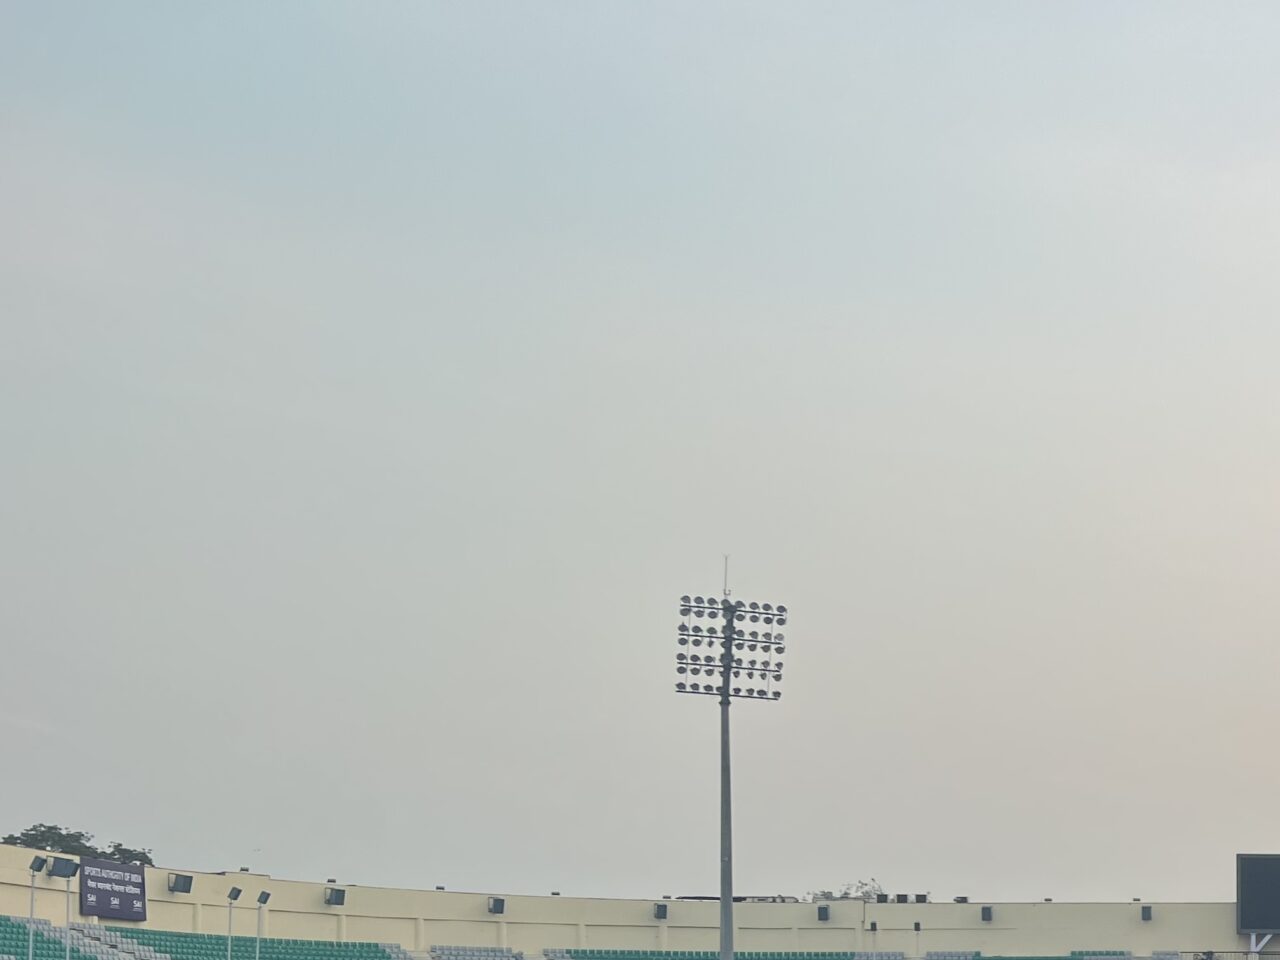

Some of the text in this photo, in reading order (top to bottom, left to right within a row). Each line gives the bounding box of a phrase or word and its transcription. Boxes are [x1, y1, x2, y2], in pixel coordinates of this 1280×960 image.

[124, 872, 130, 881] OF
[88, 894, 96, 902] SAI
[110, 896, 120, 904] SAI
